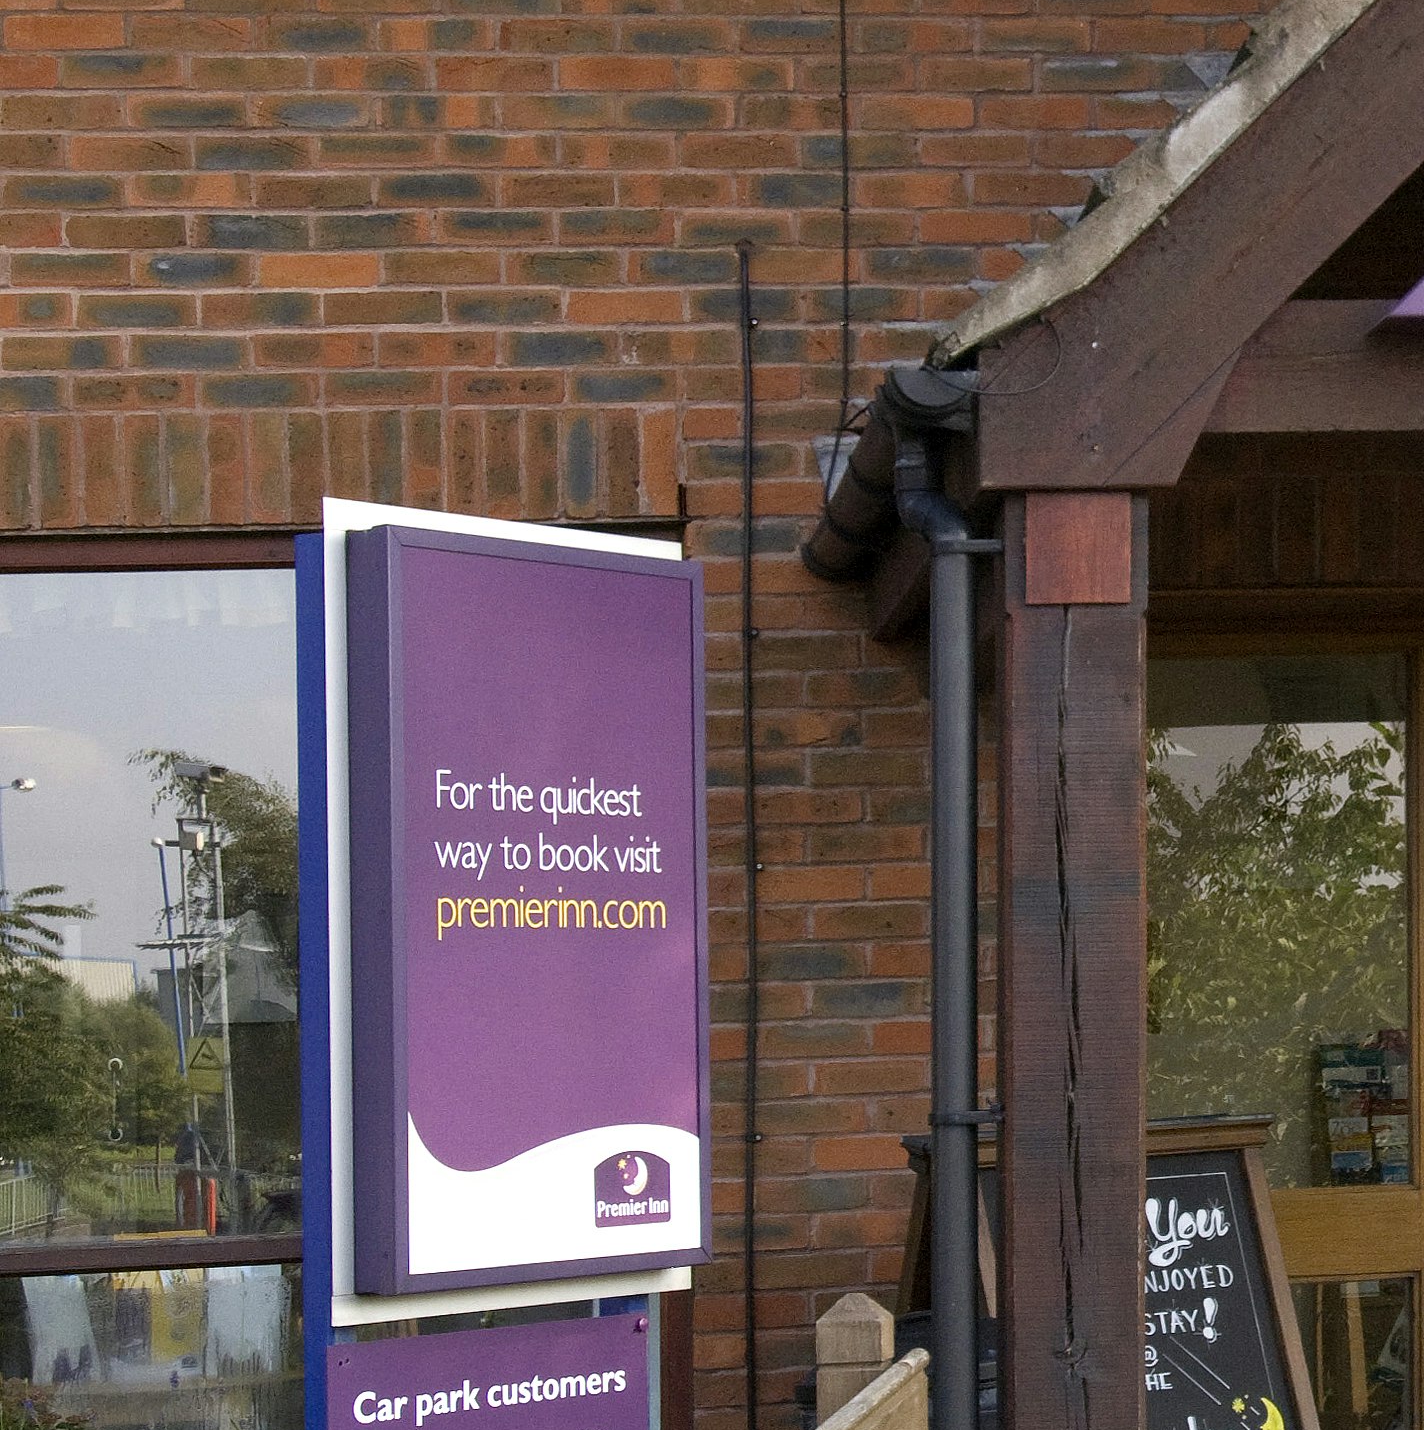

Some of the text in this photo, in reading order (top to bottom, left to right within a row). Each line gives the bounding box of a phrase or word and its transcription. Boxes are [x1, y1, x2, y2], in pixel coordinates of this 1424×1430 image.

[435, 768, 643, 826] For the quickest
[433, 832, 663, 882] way to book visit
[436, 885, 667, 941] premierinn.com
[597, 1196, 669, 1218] Premier Inn
[1145, 1197, 1230, 1267] You
[1145, 1265, 1234, 1293] NJOYED
[353, 1369, 627, 1427] Car park customers
[1145, 1372, 1174, 1392] HE
